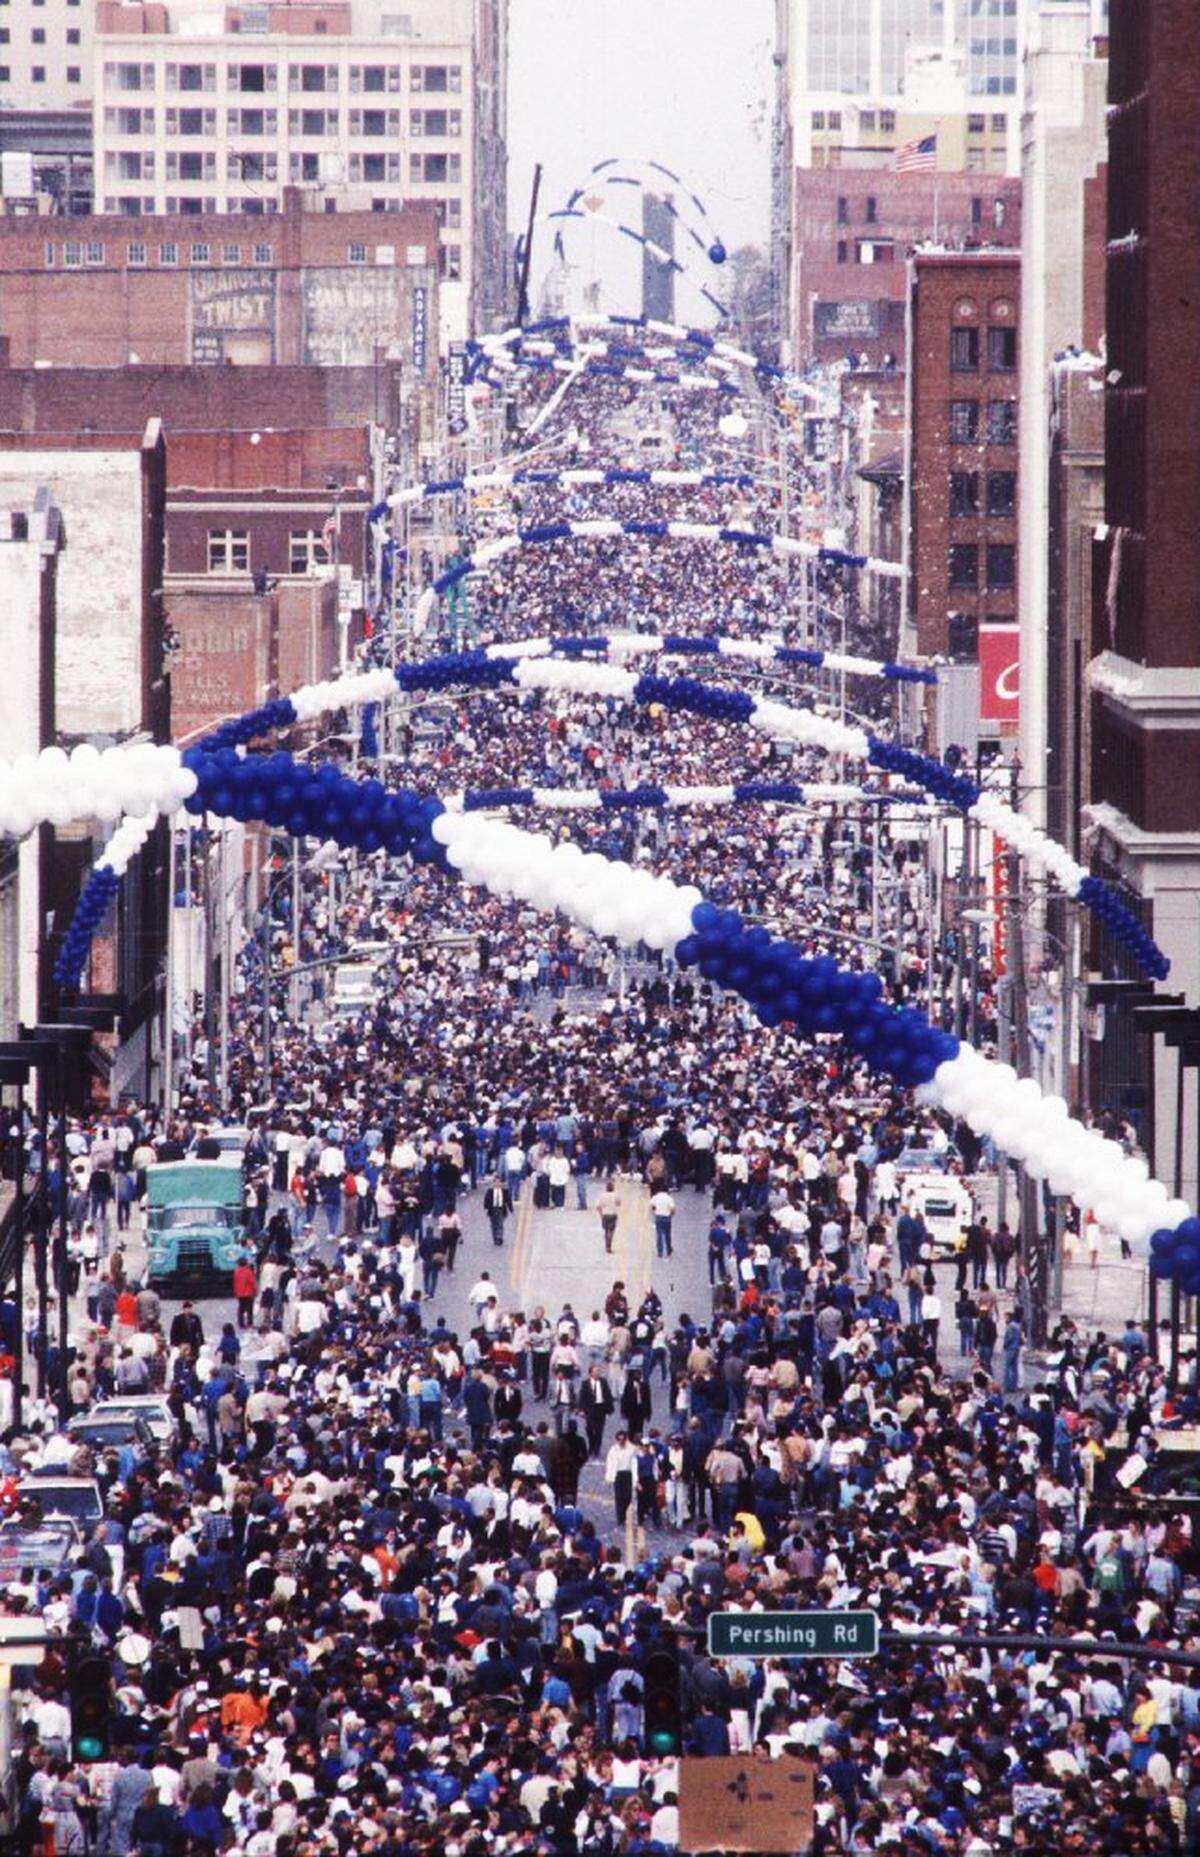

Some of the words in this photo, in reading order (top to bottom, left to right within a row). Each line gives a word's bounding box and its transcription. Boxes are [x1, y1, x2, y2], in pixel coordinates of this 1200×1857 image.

[202, 295, 270, 326] TWIST
[414, 289, 425, 366] ADVANCE
[729, 1625, 817, 1648] Pershing
[834, 1624, 858, 1643] Rd
